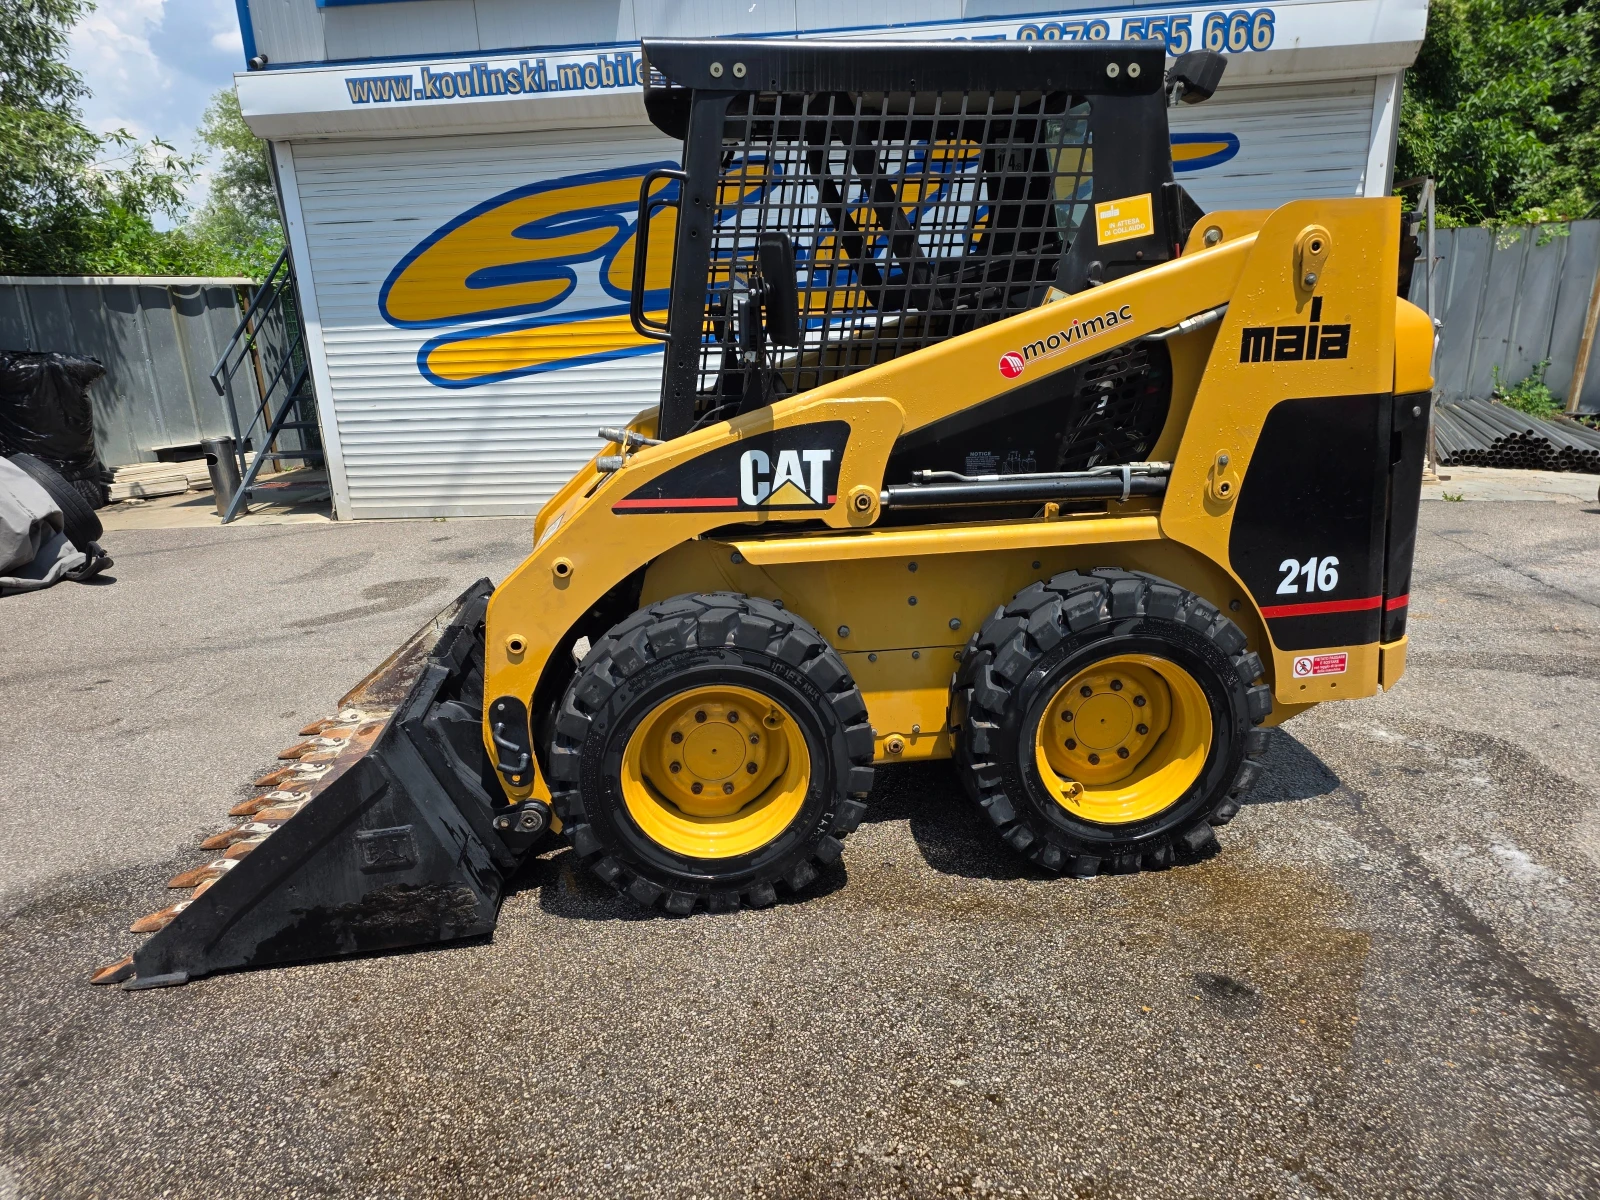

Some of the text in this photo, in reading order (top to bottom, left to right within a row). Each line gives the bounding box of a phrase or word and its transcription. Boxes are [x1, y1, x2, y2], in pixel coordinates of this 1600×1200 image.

[1202, 8, 1275, 53] 666
[1113, 223, 1145, 235] COLLAUDO
[1118, 217, 1140, 227] ATTESA
[1023, 304, 1133, 360] movimac
[1240, 296, 1351, 363] maia
[740, 449, 832, 506] CAT
[1276, 555, 1340, 595] 216
